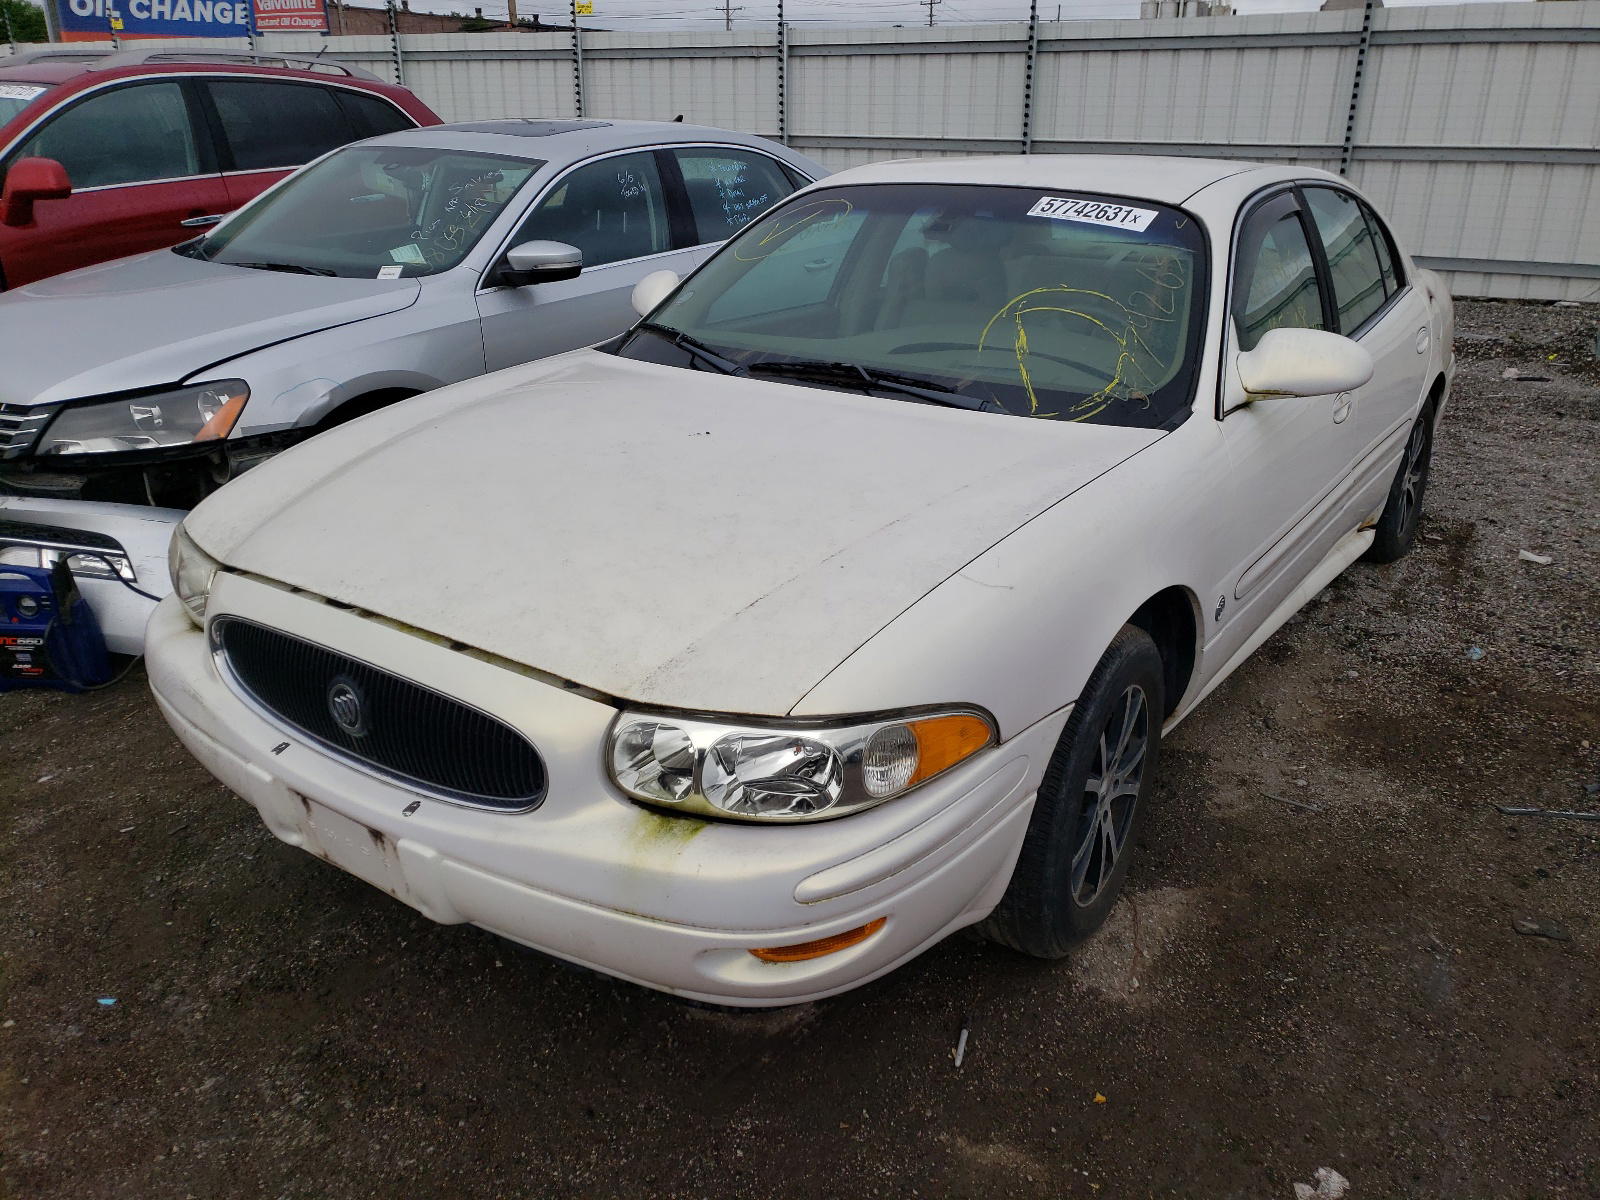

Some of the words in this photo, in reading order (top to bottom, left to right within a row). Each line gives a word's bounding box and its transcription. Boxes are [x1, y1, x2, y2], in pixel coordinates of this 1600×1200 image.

[69, 0, 120, 17] OIL
[128, 0, 247, 25] CHANGE
[280, 17, 291, 26] Oil
[291, 17, 322, 27] Change
